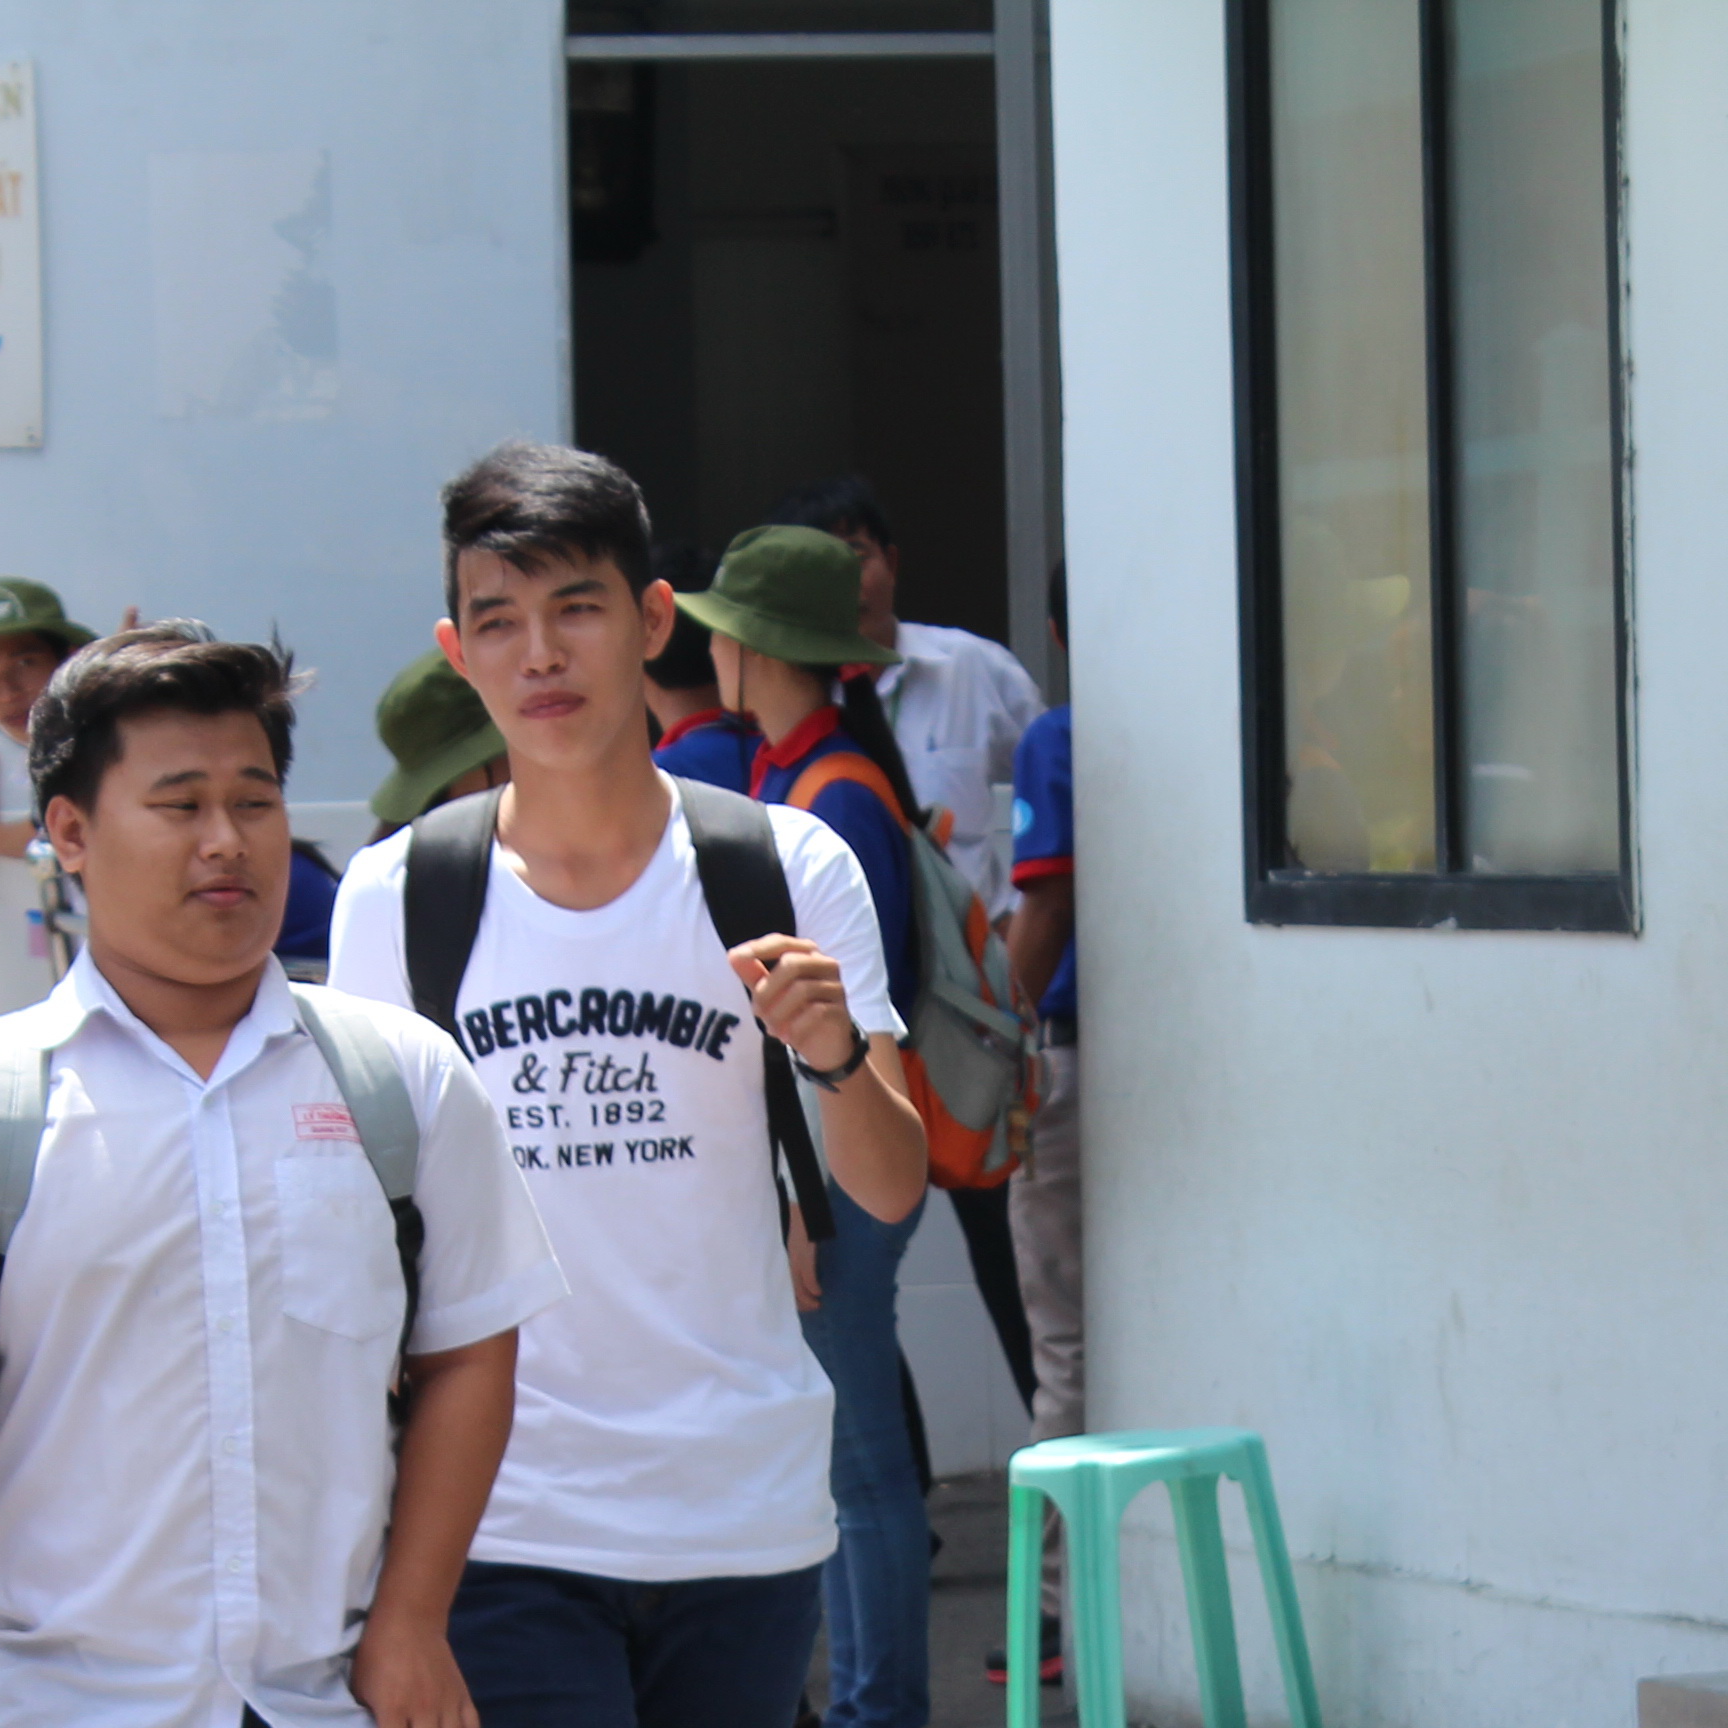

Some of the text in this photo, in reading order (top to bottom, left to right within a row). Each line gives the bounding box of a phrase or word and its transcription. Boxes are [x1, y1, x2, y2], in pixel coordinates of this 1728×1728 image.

[456, 987, 741, 1063] BERCROMBIE
[511, 1050, 658, 1095] & Fitch
[506, 1099, 666, 1130] EST. 1892
[557, 1142, 615, 1168] NEW
[624, 1135, 696, 1165] YORK
